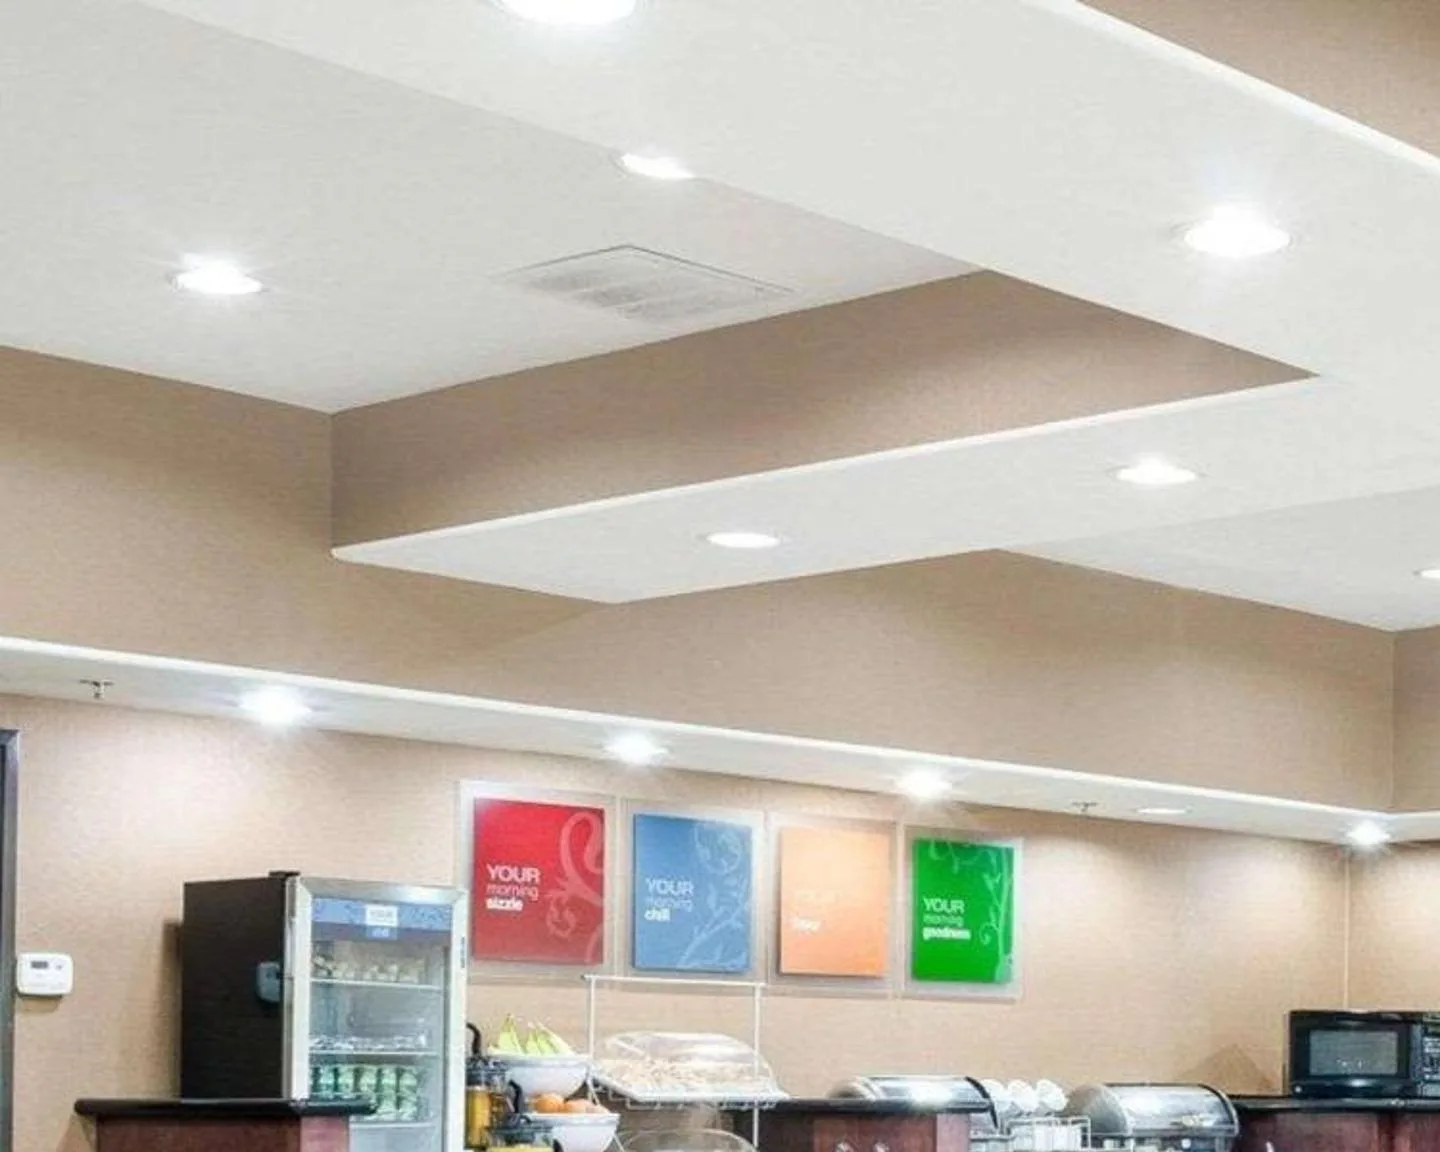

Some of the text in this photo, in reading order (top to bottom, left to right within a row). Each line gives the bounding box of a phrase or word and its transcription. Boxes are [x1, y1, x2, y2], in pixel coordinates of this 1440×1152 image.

[486, 863, 541, 884] YOUR
[486, 883, 539, 901] morning
[645, 877, 694, 896] YOUR
[922, 896, 965, 915] YOUR
